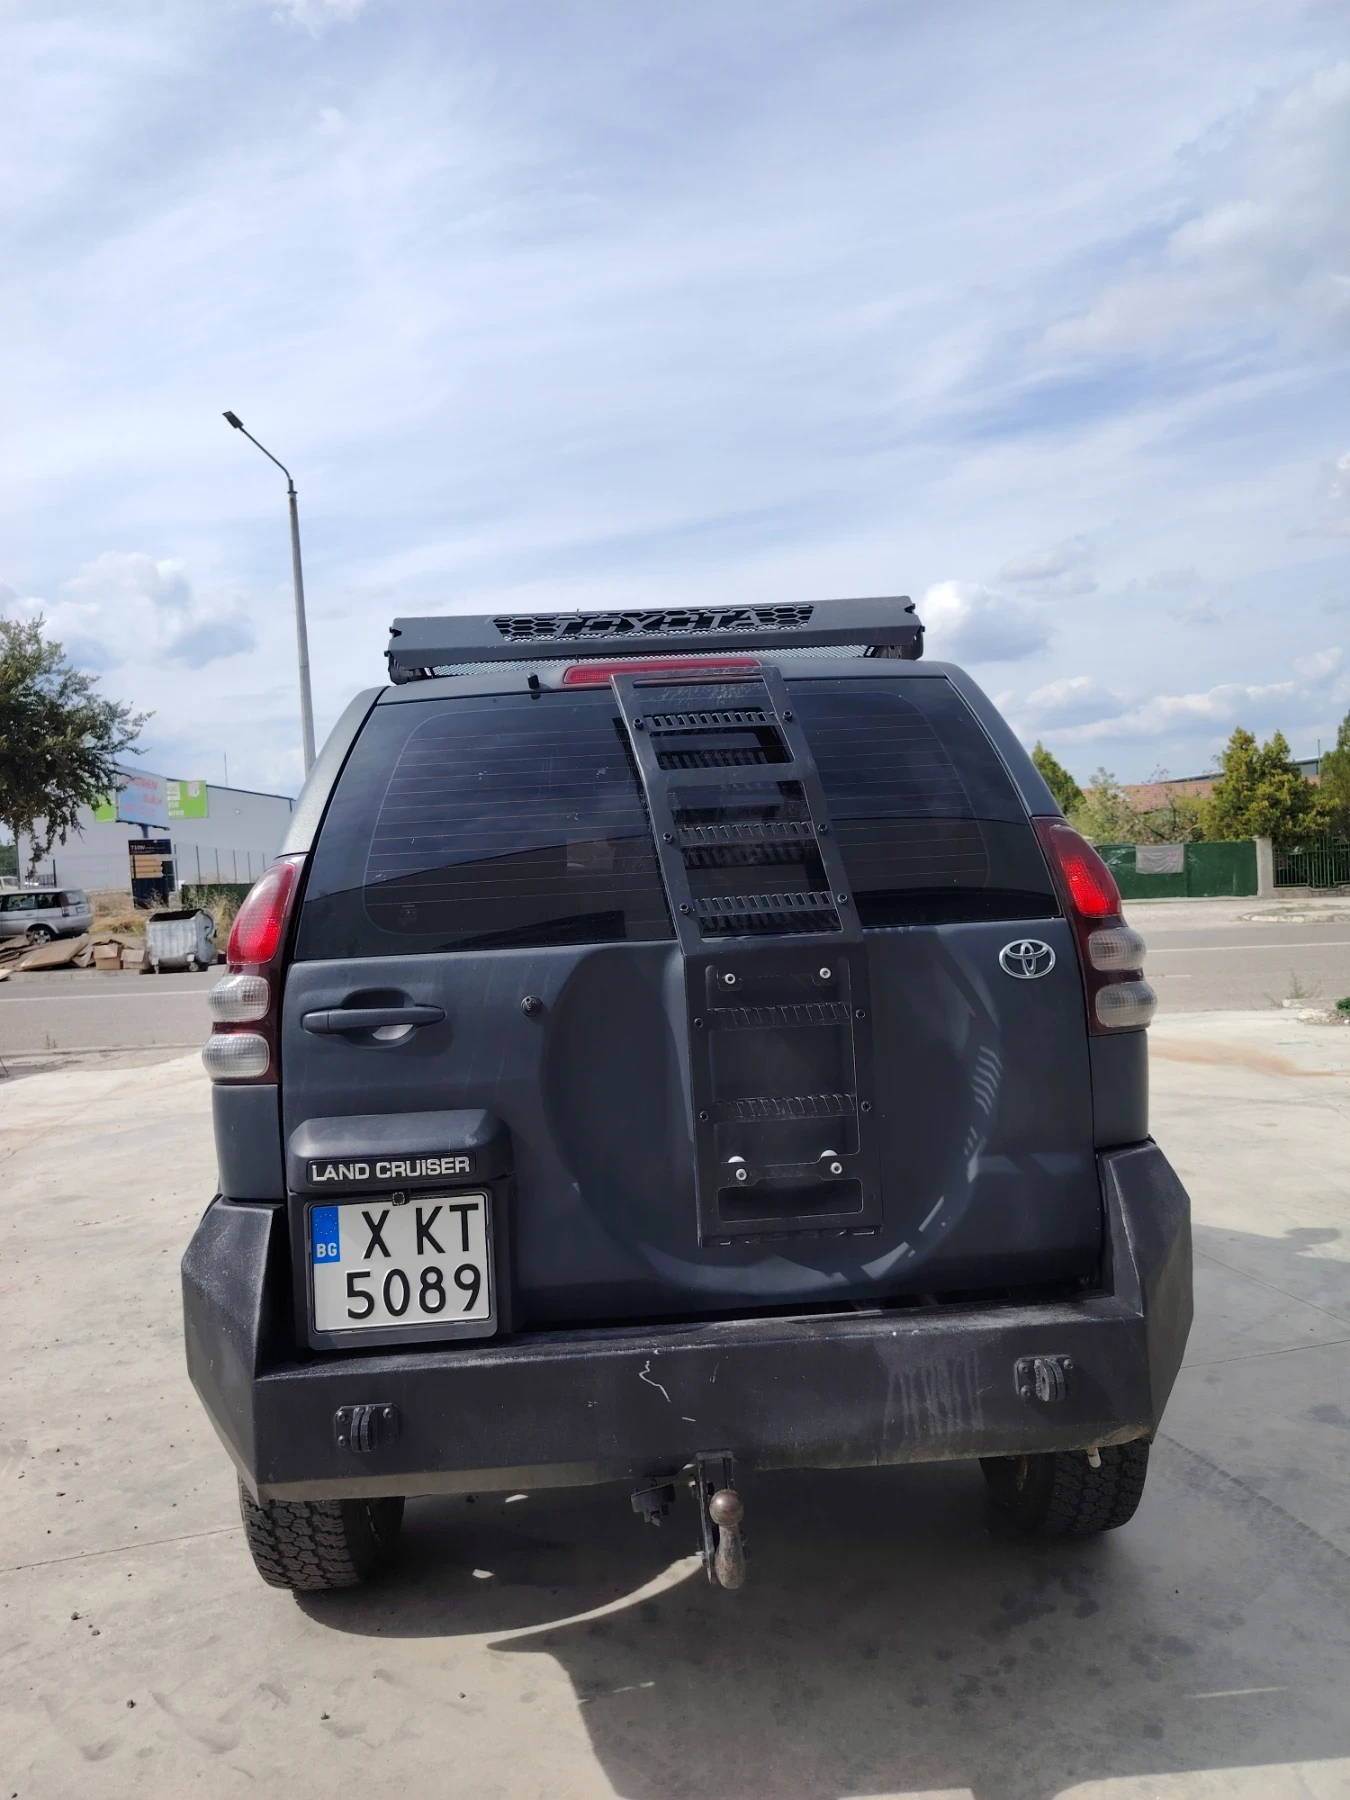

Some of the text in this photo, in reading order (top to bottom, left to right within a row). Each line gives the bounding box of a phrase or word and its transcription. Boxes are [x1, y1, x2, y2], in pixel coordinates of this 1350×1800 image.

[553, 610, 763, 639] TOYOTA
[312, 1156, 470, 1182] LAND CRUISER
[361, 1203, 479, 1260] X KT
[316, 1242, 338, 1259] BG
[345, 1263, 481, 1320] 5089
